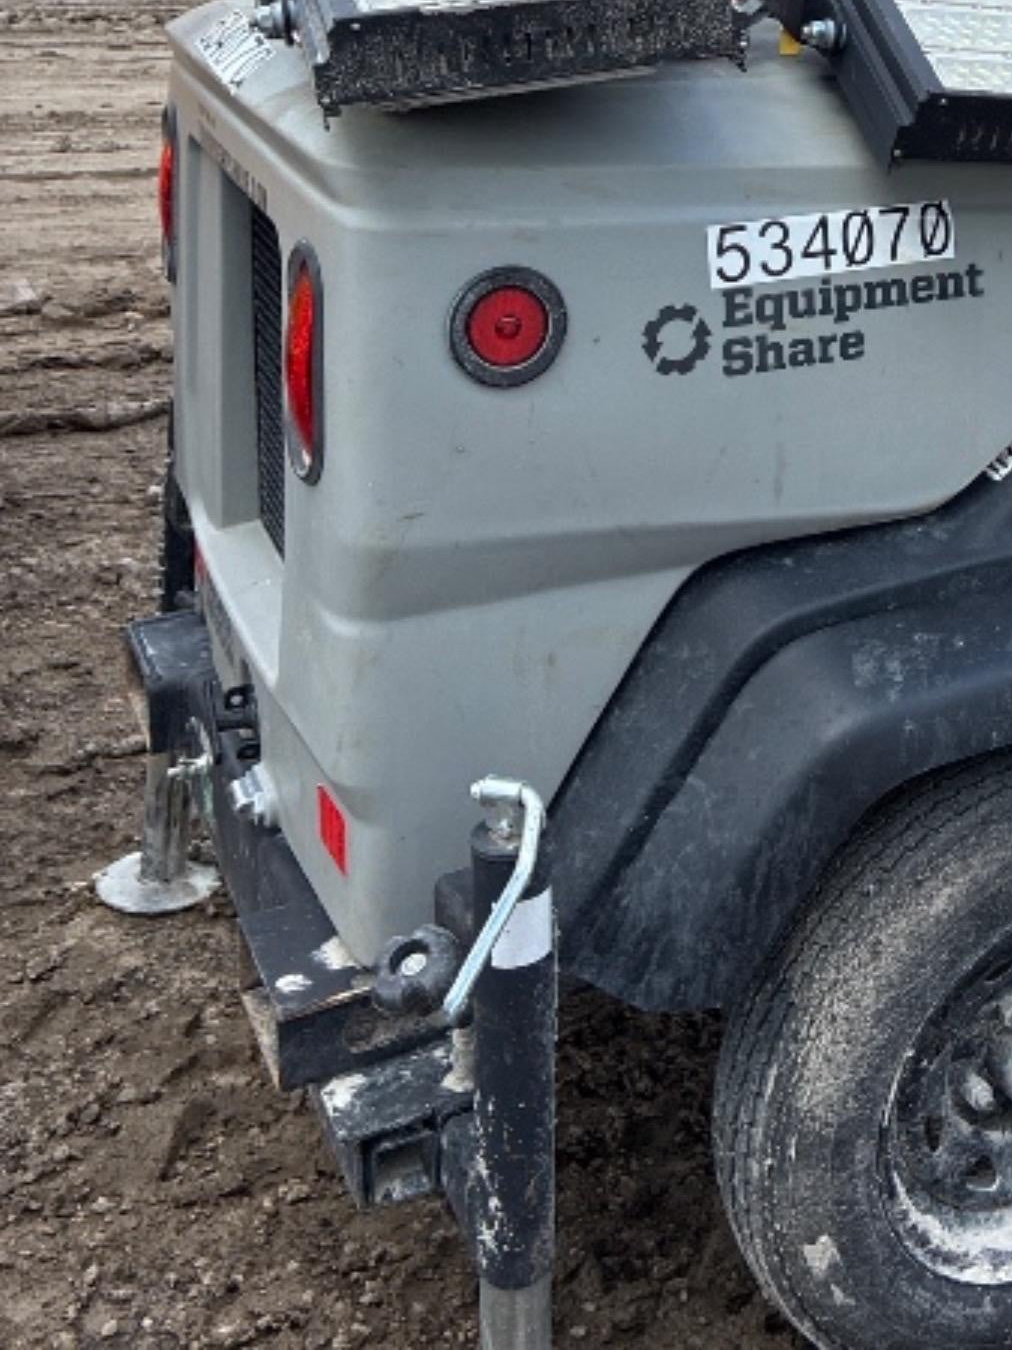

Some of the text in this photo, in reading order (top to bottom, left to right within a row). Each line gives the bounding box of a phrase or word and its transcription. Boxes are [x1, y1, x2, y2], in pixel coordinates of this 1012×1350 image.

[714, 201, 950, 284] 534070
[721, 263, 985, 330] Equipment
[722, 330, 866, 377] Share
